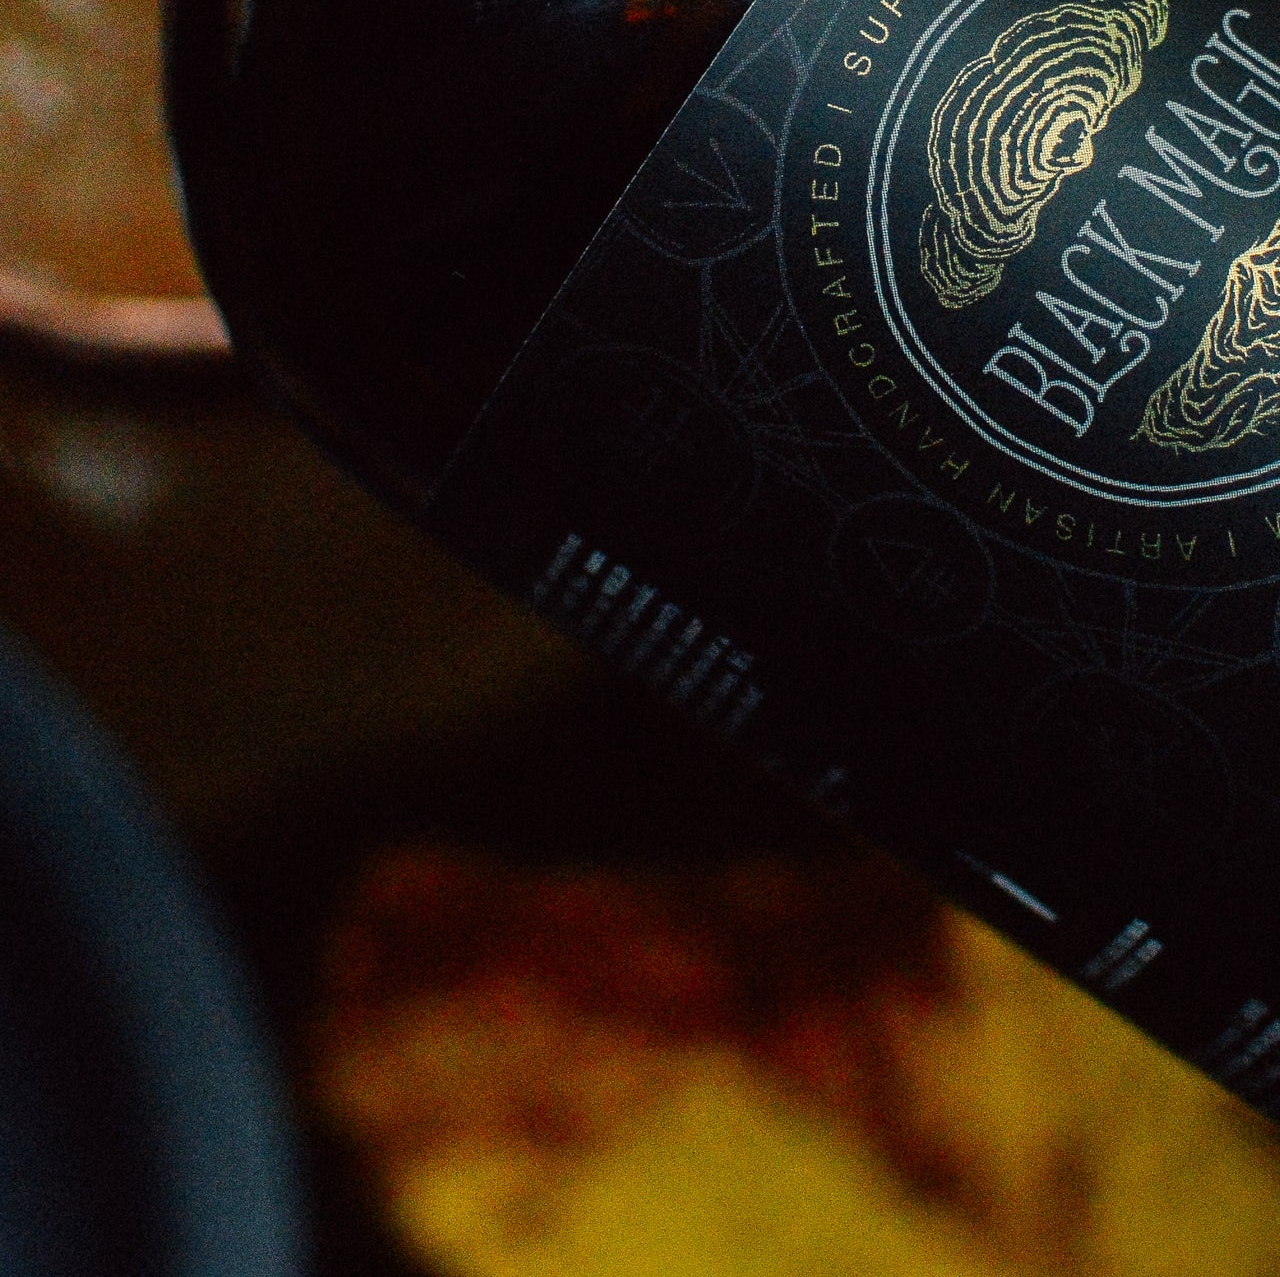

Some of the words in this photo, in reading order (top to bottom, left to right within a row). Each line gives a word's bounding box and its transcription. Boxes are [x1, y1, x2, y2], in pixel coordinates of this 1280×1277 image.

[810, 143, 970, 481] HANDCRAFTED
[982, 199, 1201, 438] BLACK
[988, 481, 1198, 562] ARTISAN
